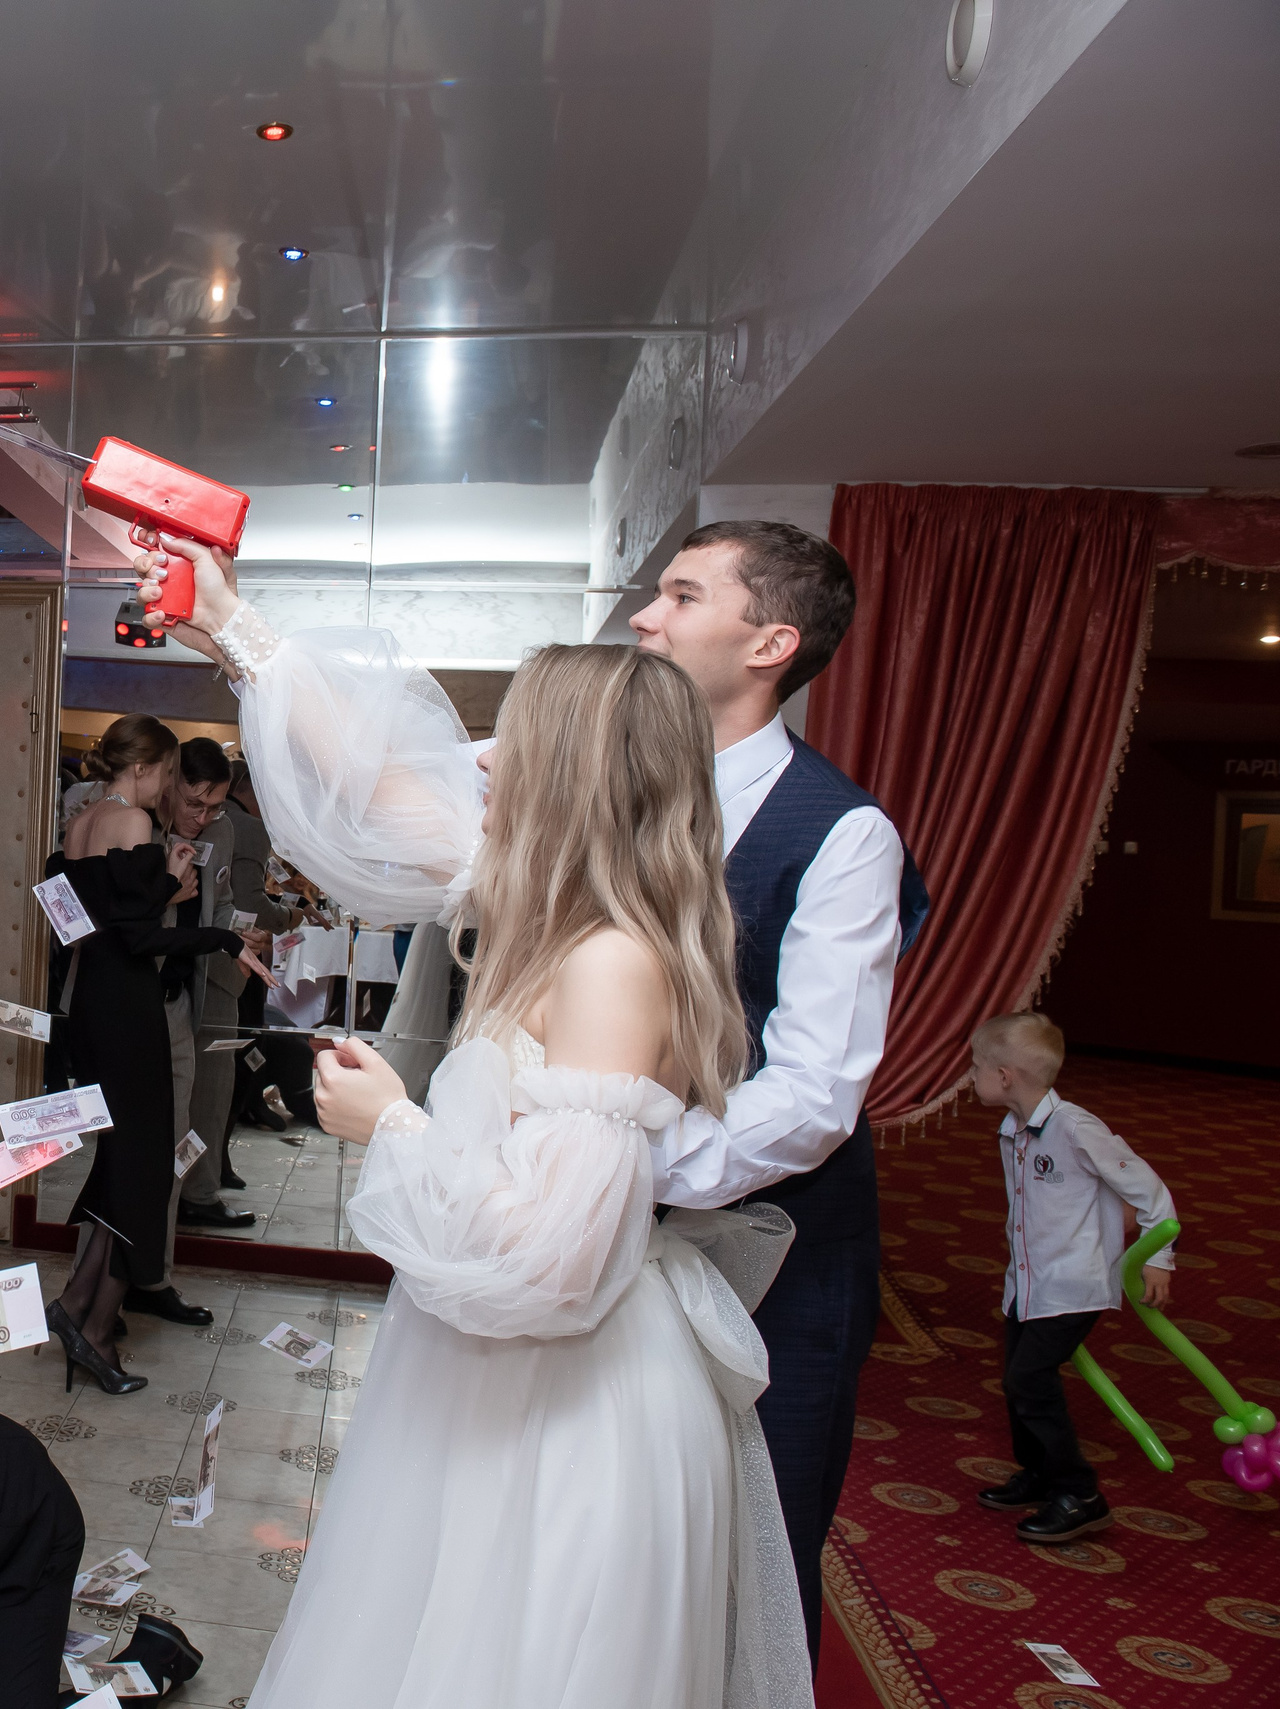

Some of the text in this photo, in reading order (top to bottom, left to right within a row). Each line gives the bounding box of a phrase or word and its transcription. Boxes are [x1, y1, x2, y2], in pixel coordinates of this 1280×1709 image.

[1225, 758, 1280, 778] ГАРД
[11, 1107, 37, 1122] 500
[1, 1278, 22, 1291] 100
